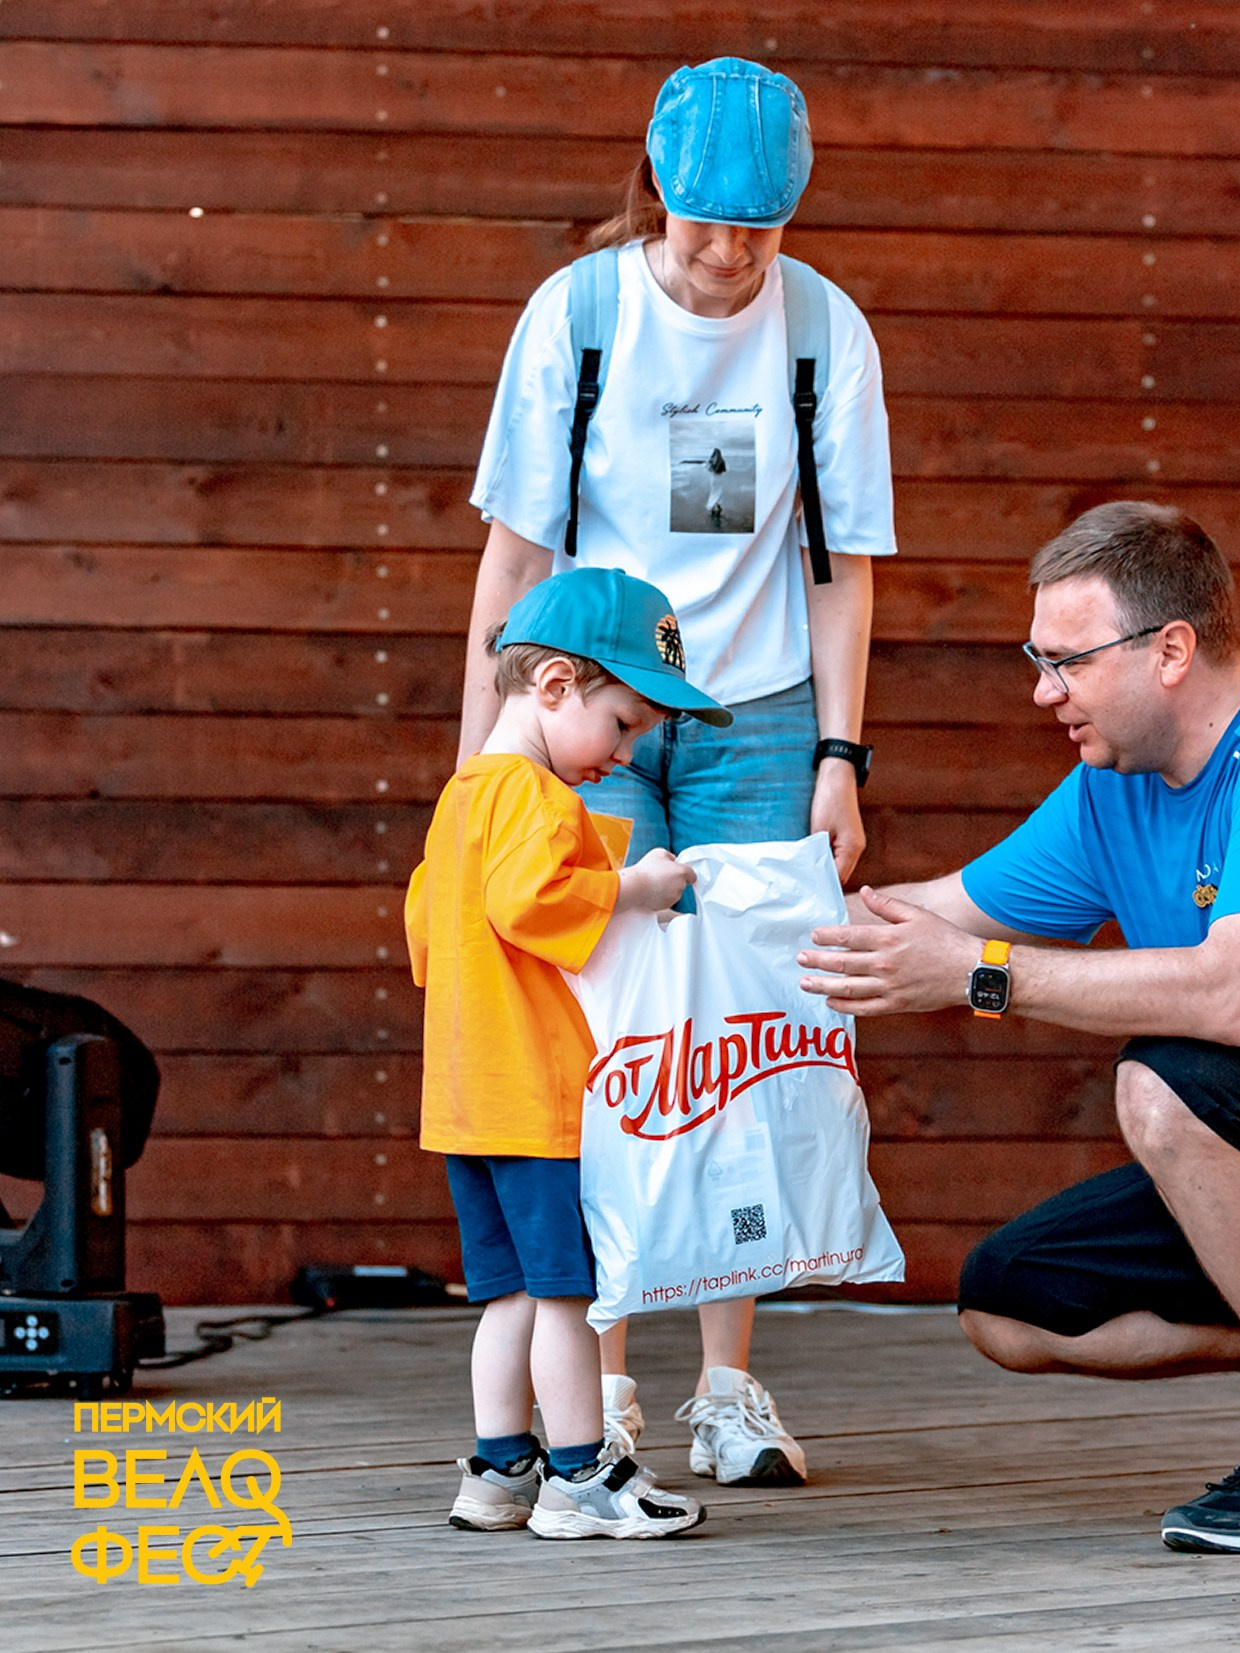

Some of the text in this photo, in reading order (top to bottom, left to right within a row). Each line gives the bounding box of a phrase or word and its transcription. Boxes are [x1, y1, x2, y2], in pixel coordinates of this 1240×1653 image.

[661, 401, 763, 418] Stylish Community
[604, 1054, 654, 1108] от
[641, 1243, 865, 1305] https://taplink.cc/martinura
